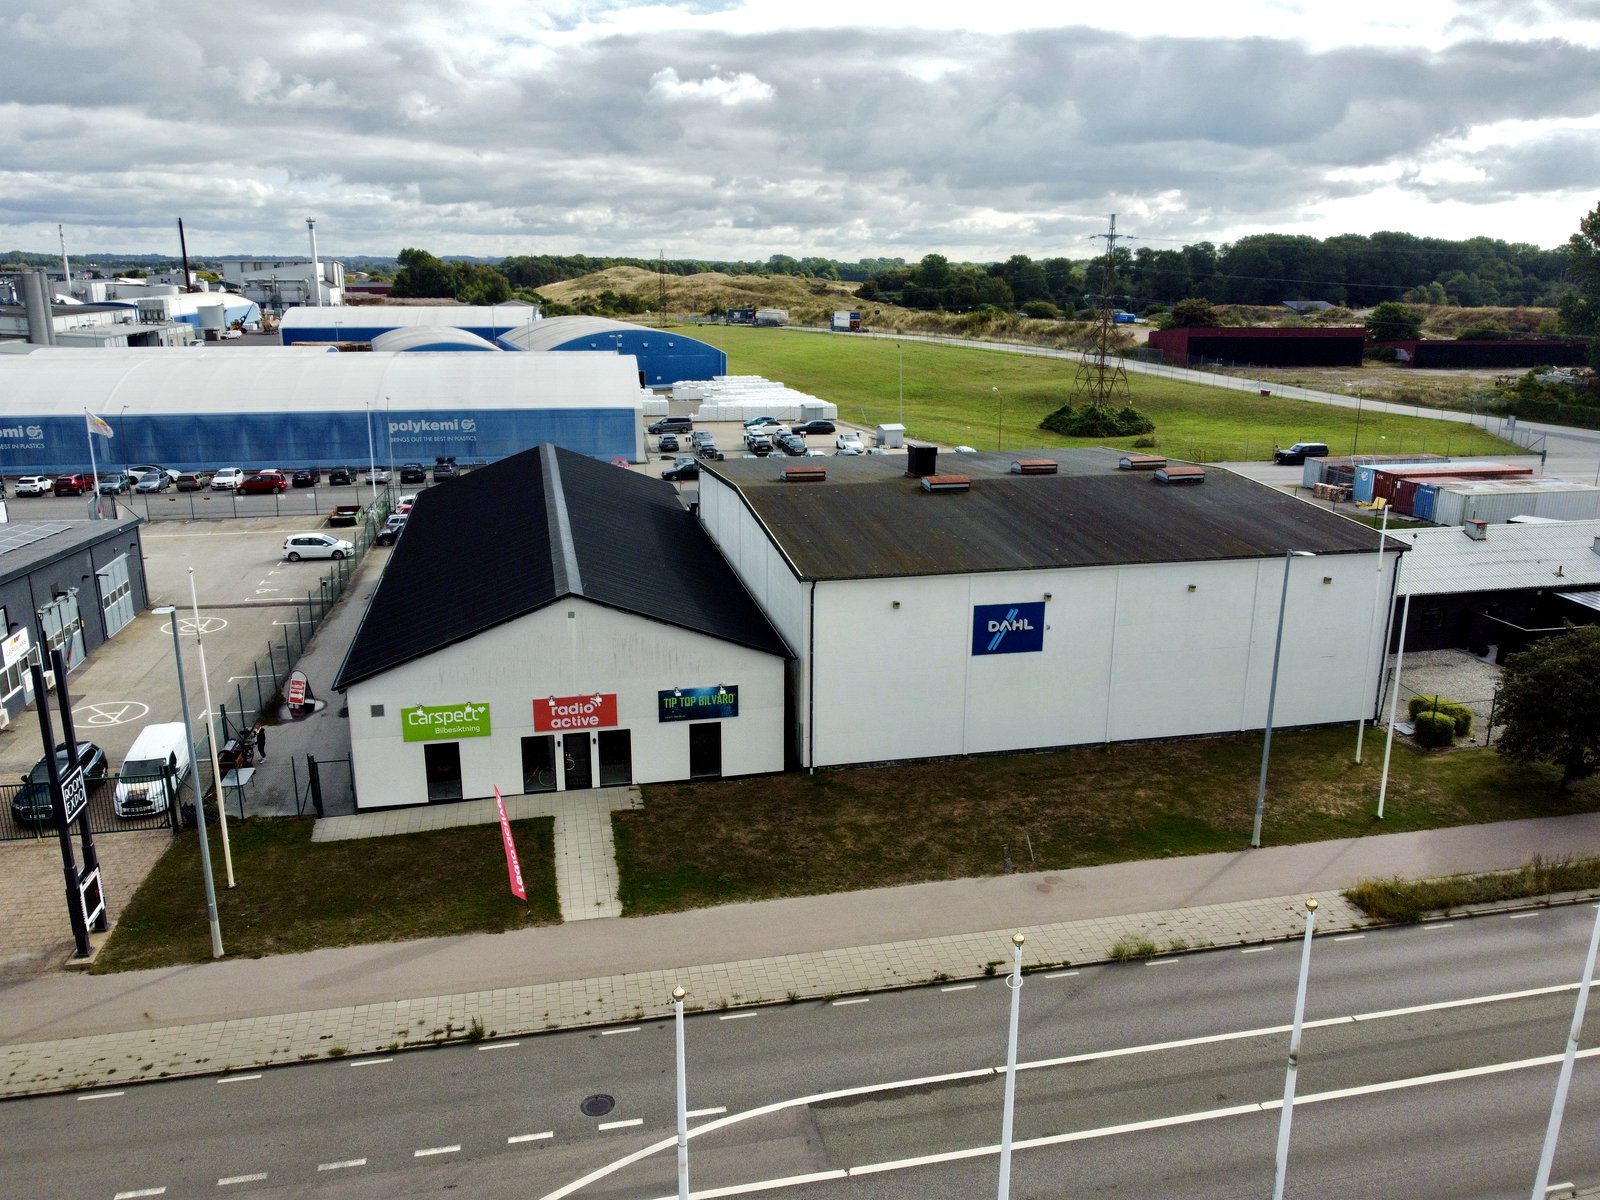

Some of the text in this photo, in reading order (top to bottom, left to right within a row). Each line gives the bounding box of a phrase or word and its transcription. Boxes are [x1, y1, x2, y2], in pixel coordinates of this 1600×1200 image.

[0, 425, 24, 437] mi
[388, 419, 459, 434] polykemi
[987, 618, 1034, 633] DAHL
[550, 702, 595, 717] radio
[664, 696, 678, 709] TIP
[679, 696, 697, 708] TOP
[408, 707, 480, 726] Carspect
[550, 715, 600, 729] active
[434, 725, 481, 735] Bilbesiktning
[64, 774, 83, 801] ROOM
[66, 788, 84, 815] EXPO
